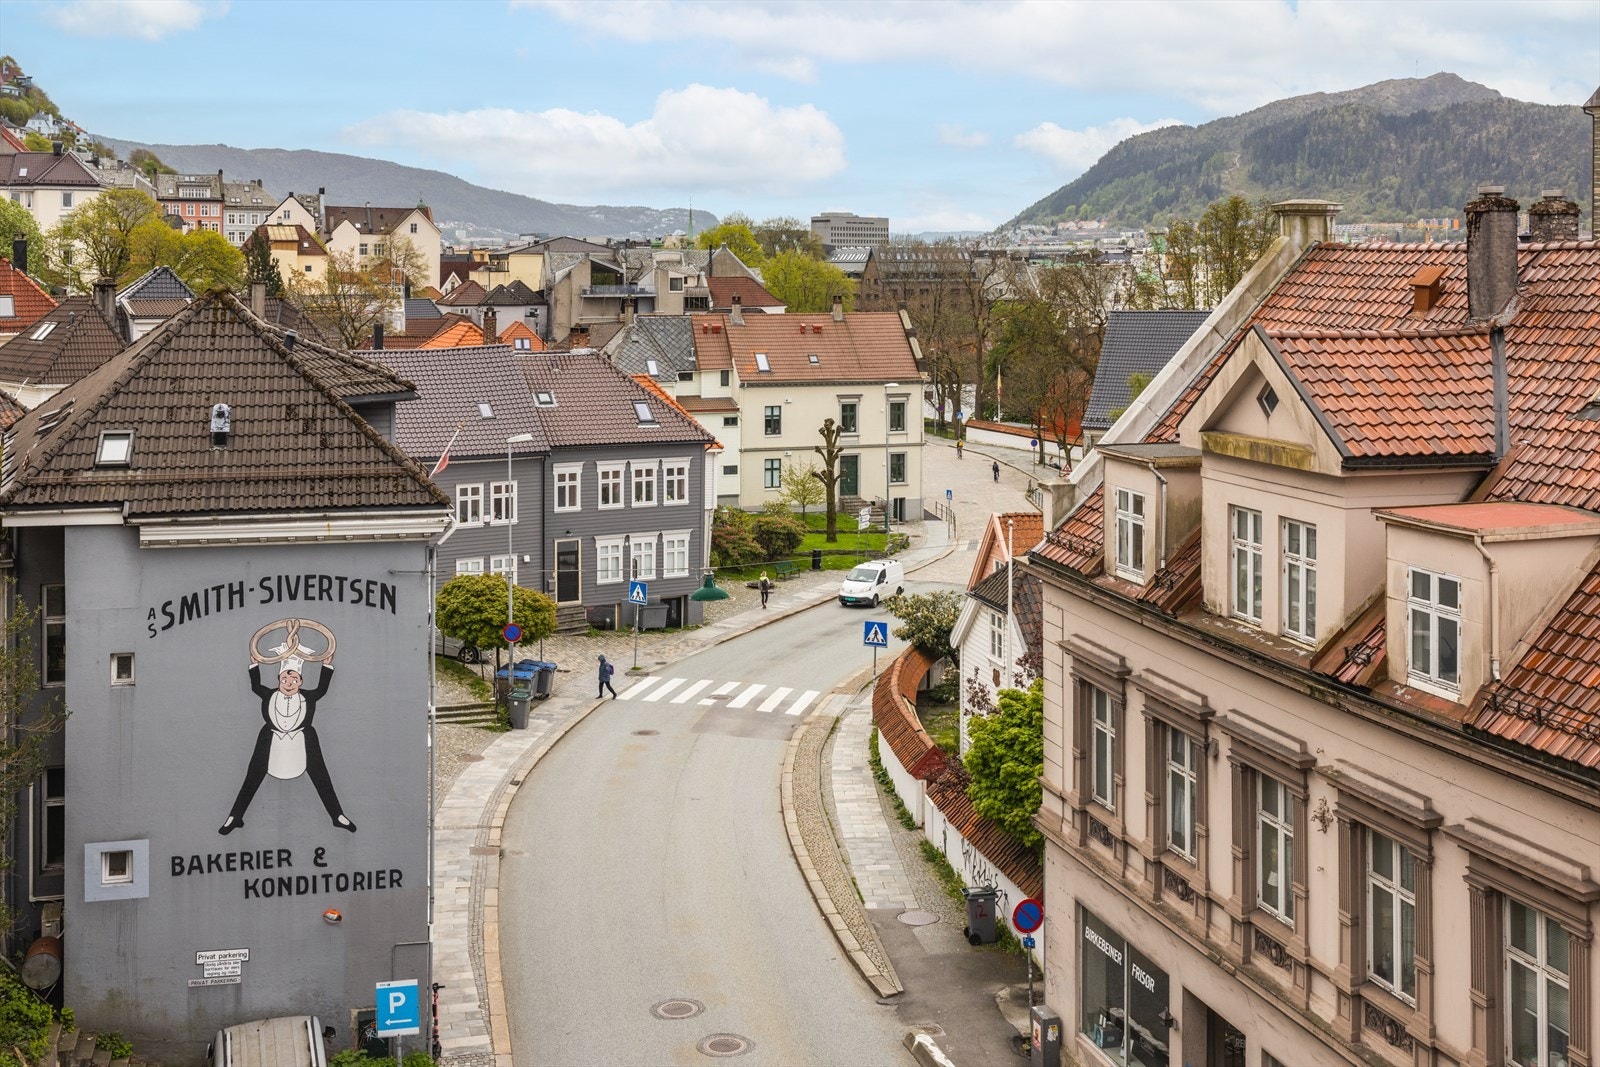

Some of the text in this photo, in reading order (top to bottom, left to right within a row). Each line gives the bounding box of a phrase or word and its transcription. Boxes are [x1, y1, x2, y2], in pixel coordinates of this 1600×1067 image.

[171, 846, 328, 877] BAKERIER &
[244, 869, 403, 899] KONDITORIER
[1085, 926, 1155, 993] BIRKEBEINER FRISØR
[389, 991, 406, 1014] P
